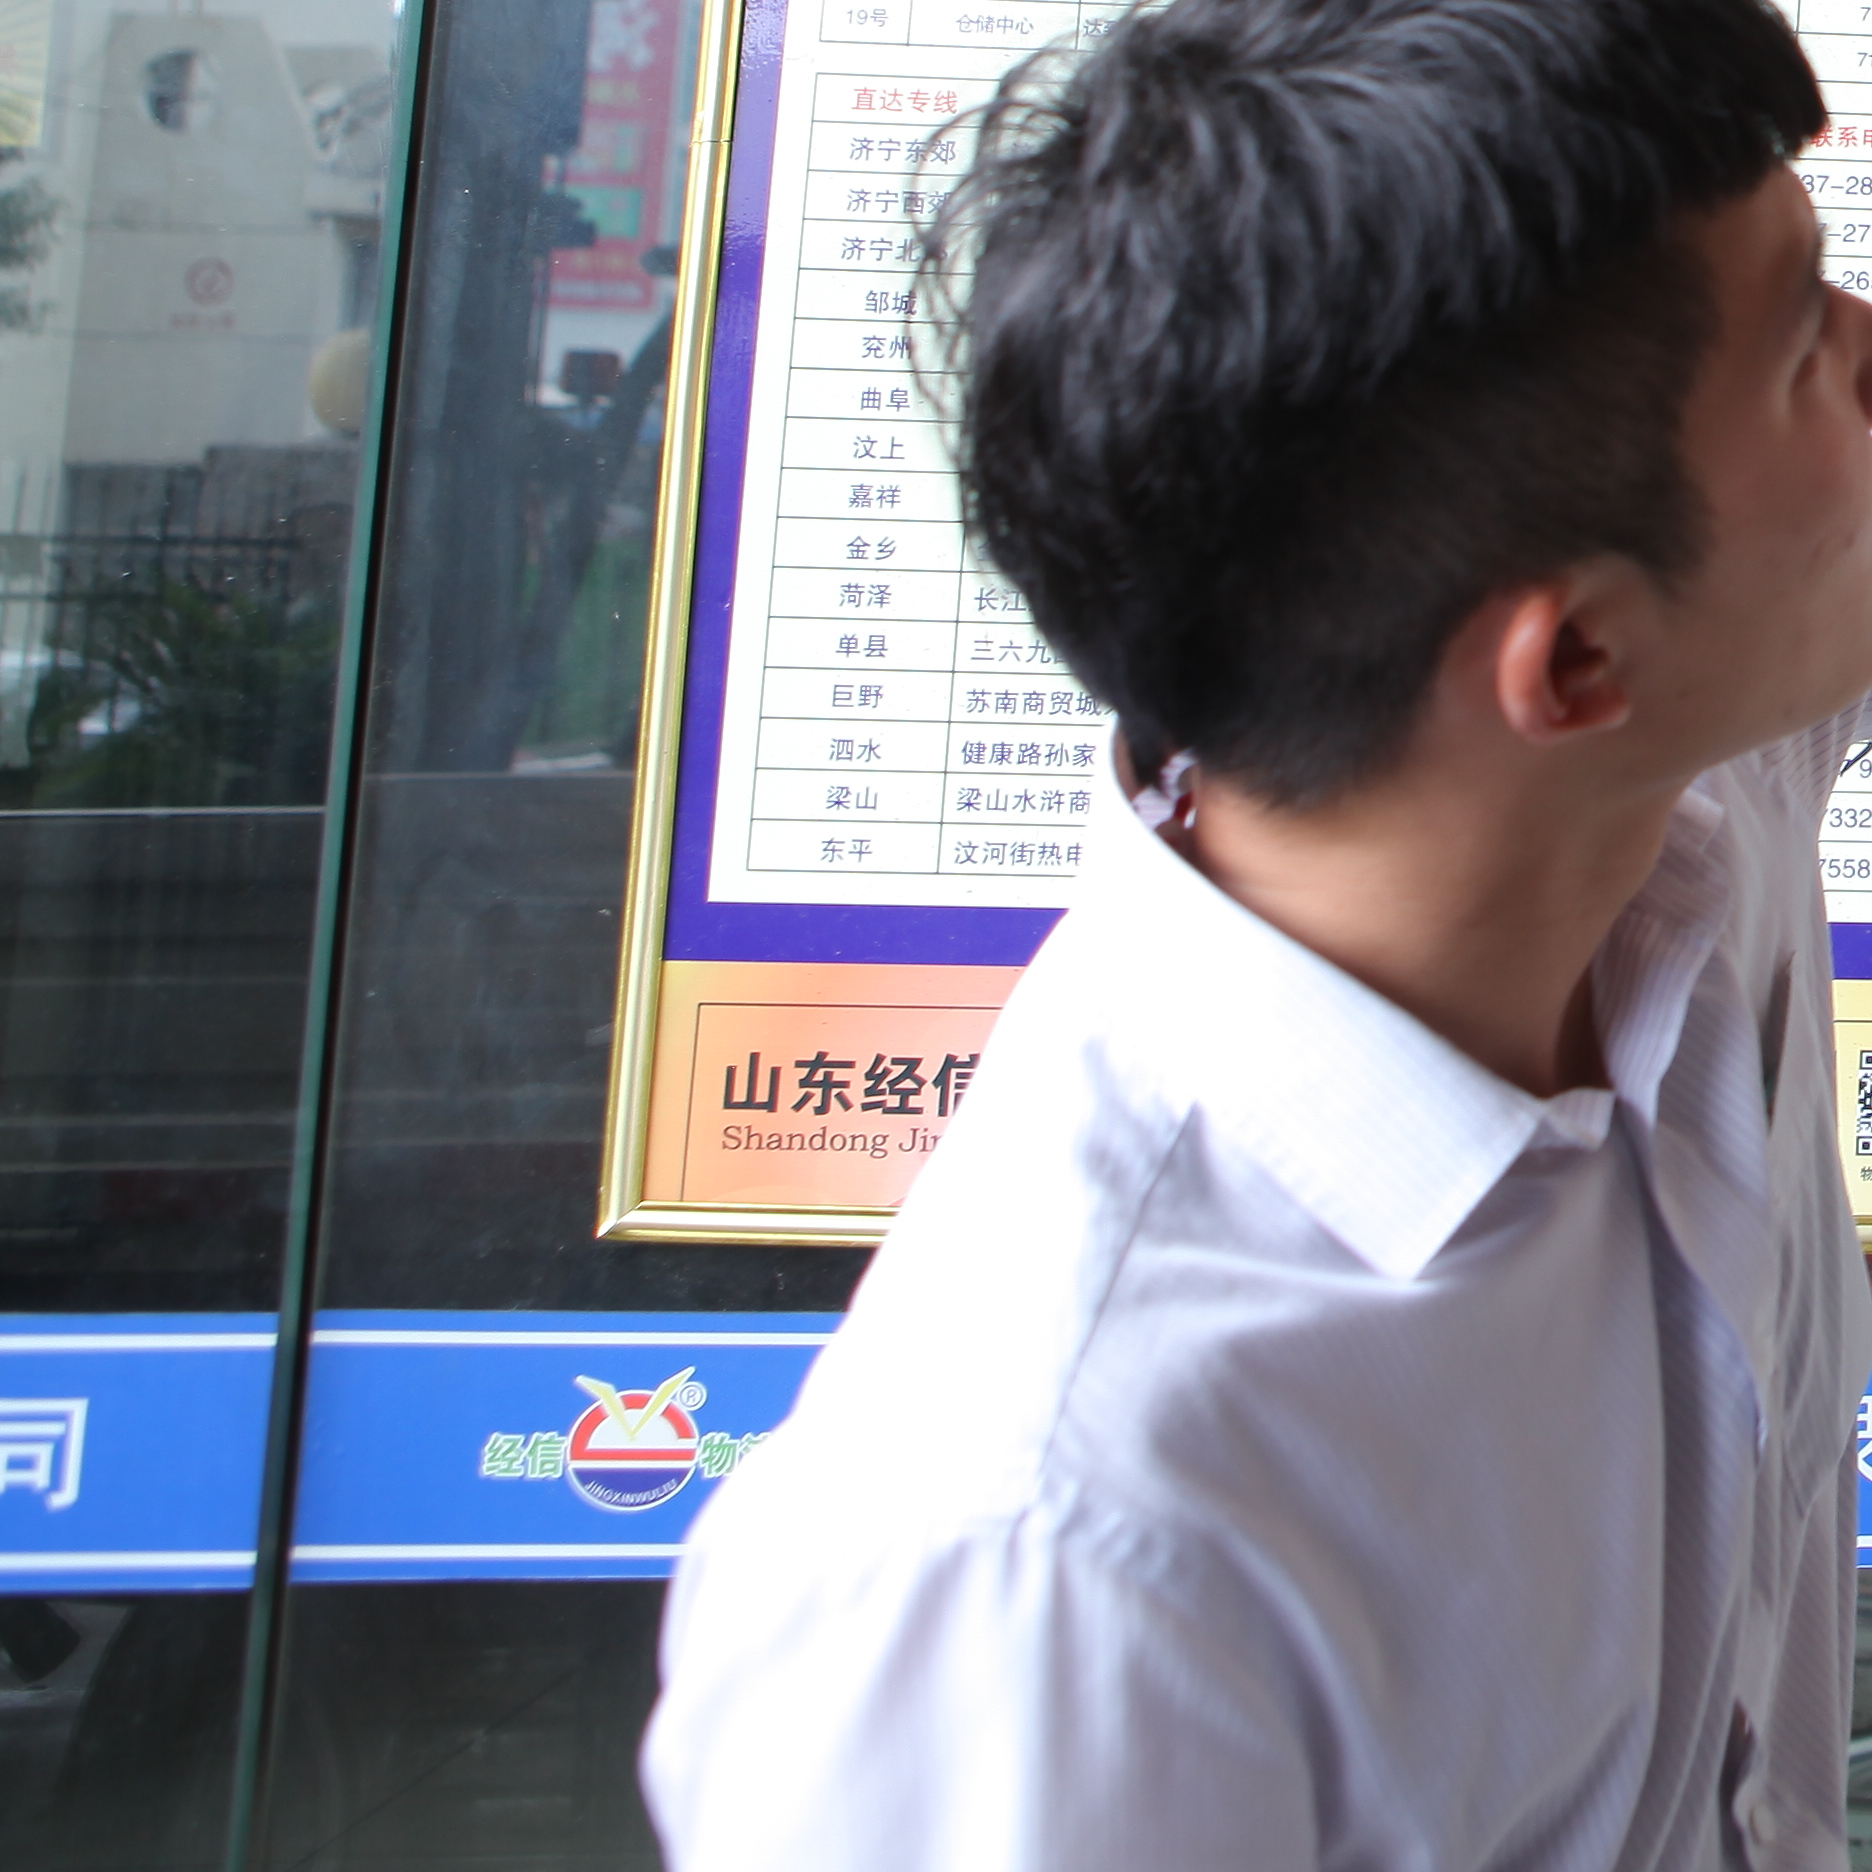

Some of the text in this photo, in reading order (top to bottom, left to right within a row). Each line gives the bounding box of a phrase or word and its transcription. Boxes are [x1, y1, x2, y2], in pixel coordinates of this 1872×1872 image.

[845, 9, 889, 29] 19号
[955, 14, 1035, 38] 仓储中心
[851, 86, 959, 115] 直达专线
[848, 136, 957, 165] 济宁东郊
[863, 289, 918, 316] 邹城
[860, 335, 914, 361] 兖州
[859, 386, 912, 412] 曲阜
[852, 435, 906, 461] 汶上
[848, 483, 902, 510] 嘉祥
[845, 535, 898, 562] 金乡
[838, 582, 894, 610] 菏泽
[973, 586, 1033, 613] 长江
[835, 633, 890, 660] 单县
[970, 639, 1067, 665] 三六九
[831, 683, 885, 710] 巨野
[965, 687, 1115, 716] 苏南商贸城
[827, 736, 883, 764] 泗水
[825, 784, 879, 812] 梁山
[819, 837, 875, 864] 东平
[721, 1124, 890, 1159] Shandong
[480, 1430, 568, 1480] 经信
